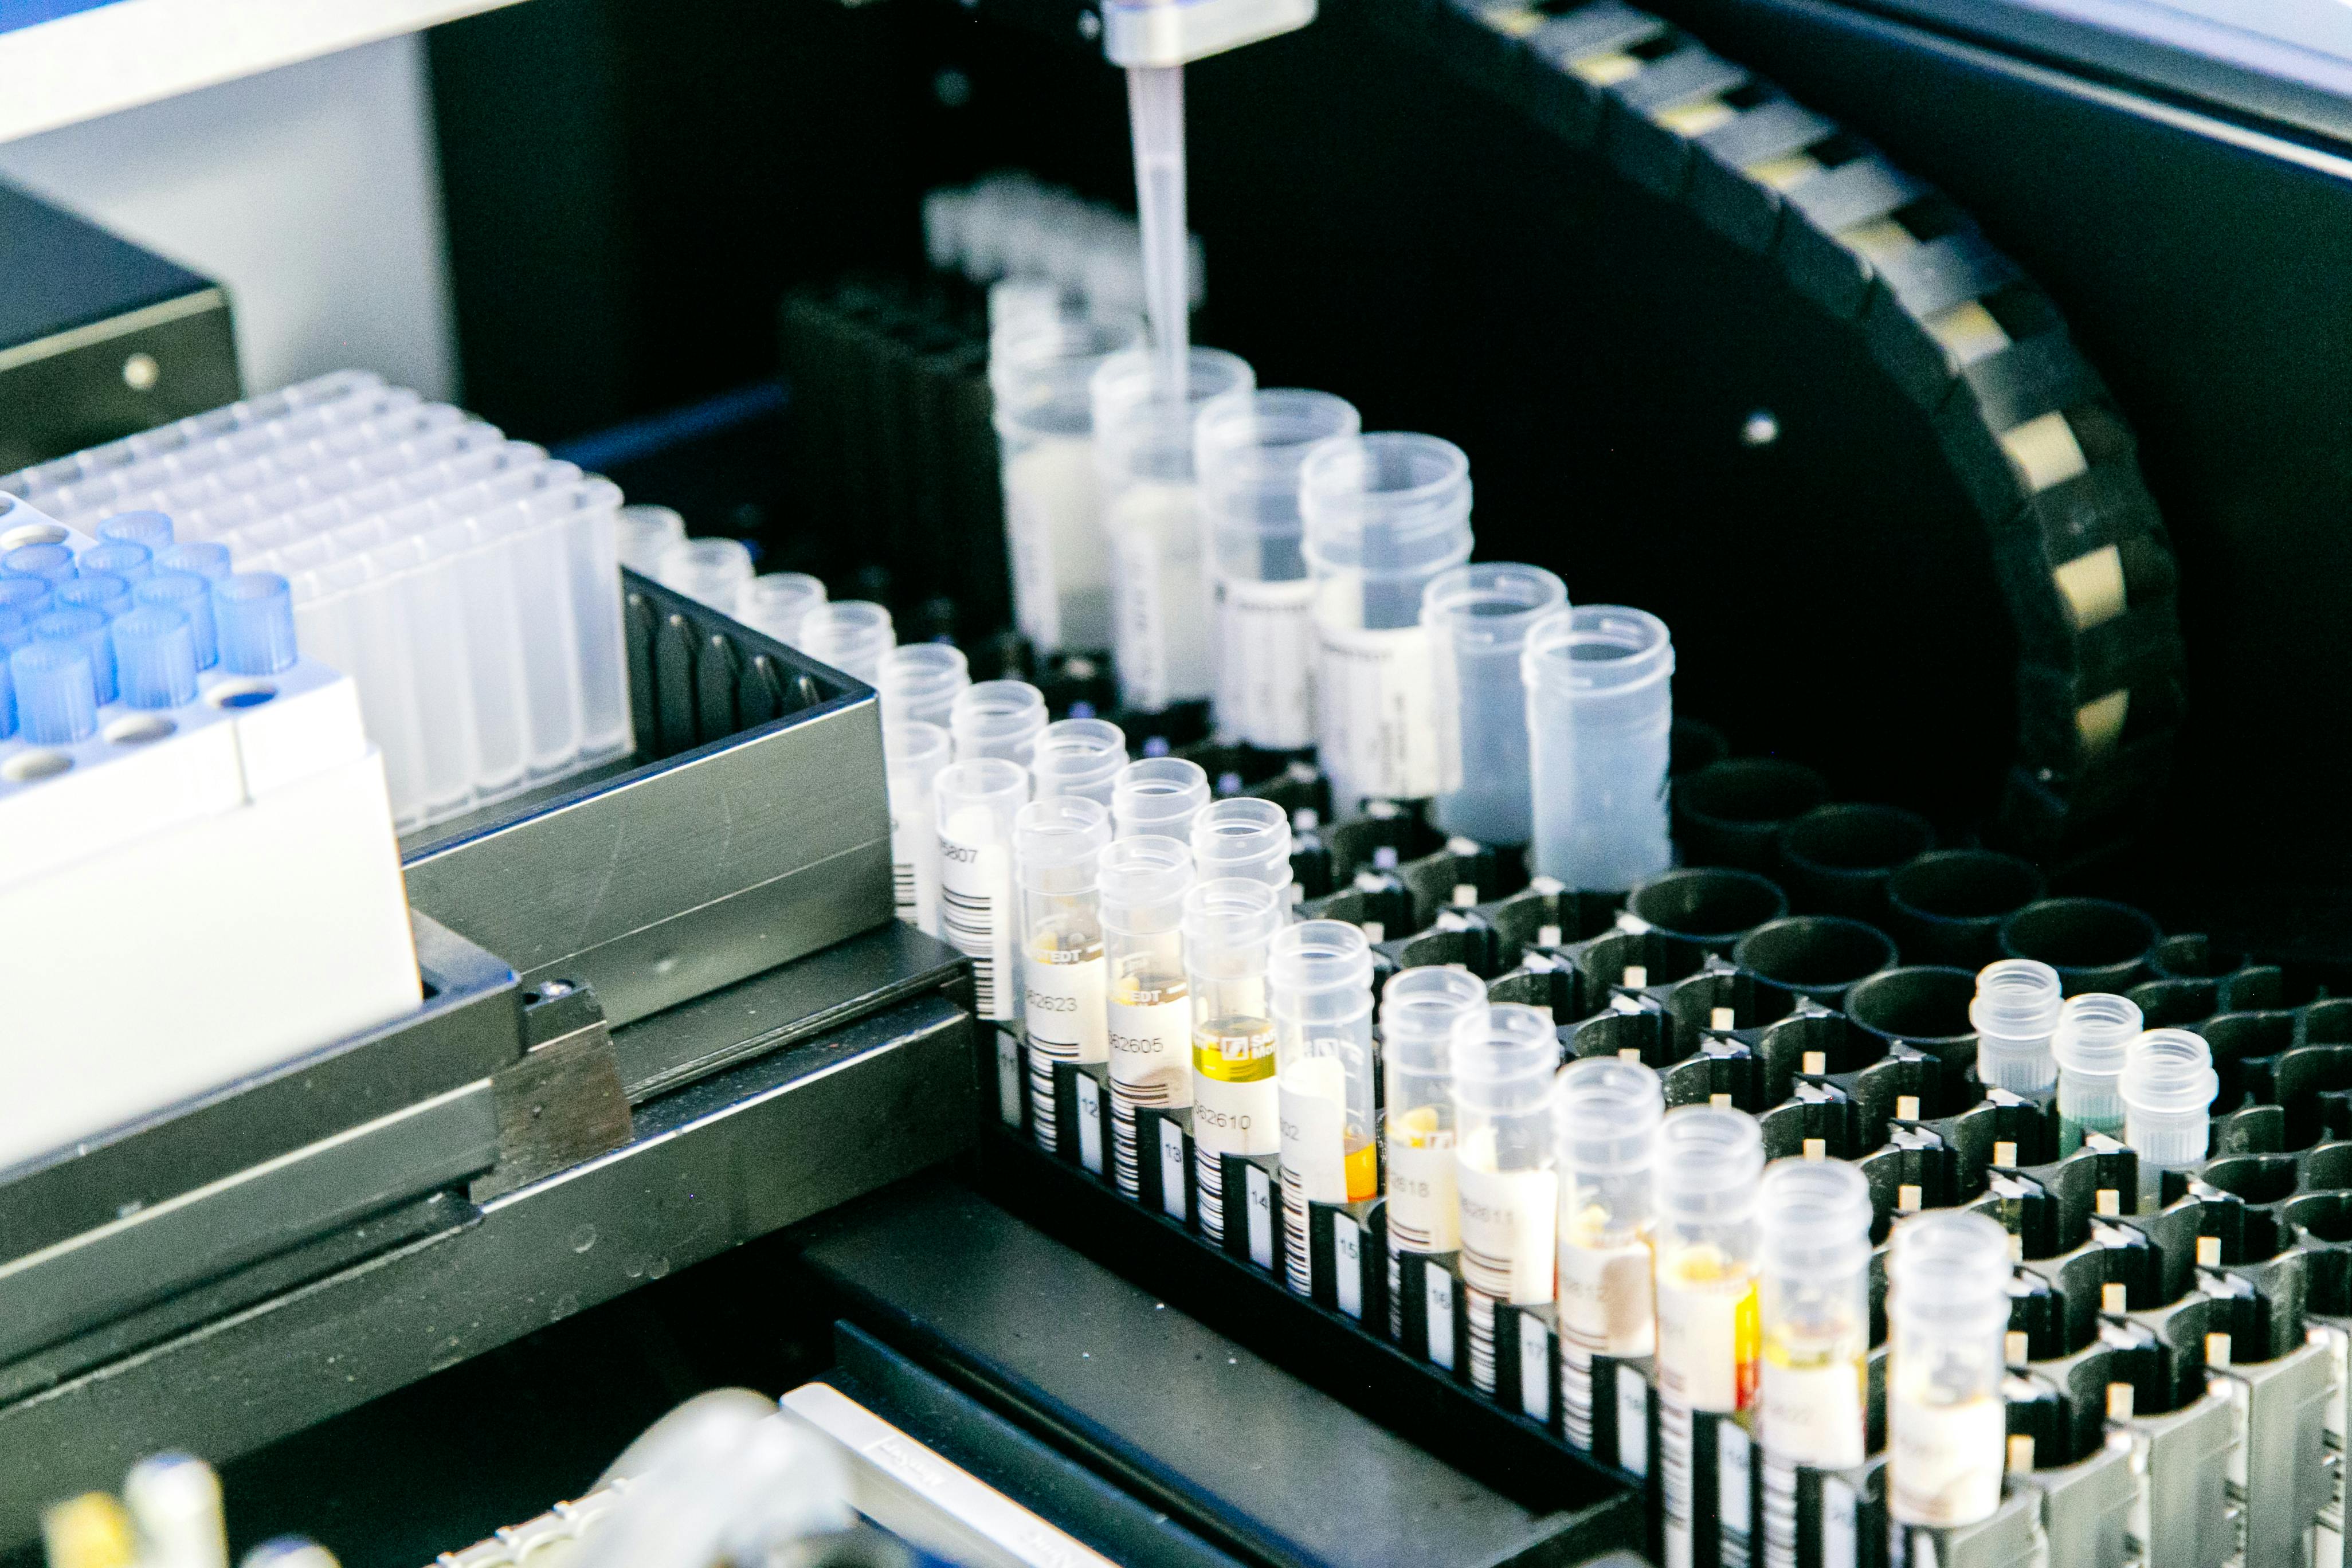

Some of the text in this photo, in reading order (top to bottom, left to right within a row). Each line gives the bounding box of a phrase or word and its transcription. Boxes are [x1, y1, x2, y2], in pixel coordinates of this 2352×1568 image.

[1165, 1143, 1182, 1163] 13
[1252, 1190, 1269, 1210] 14
[1340, 1238, 1359, 1260] 15
